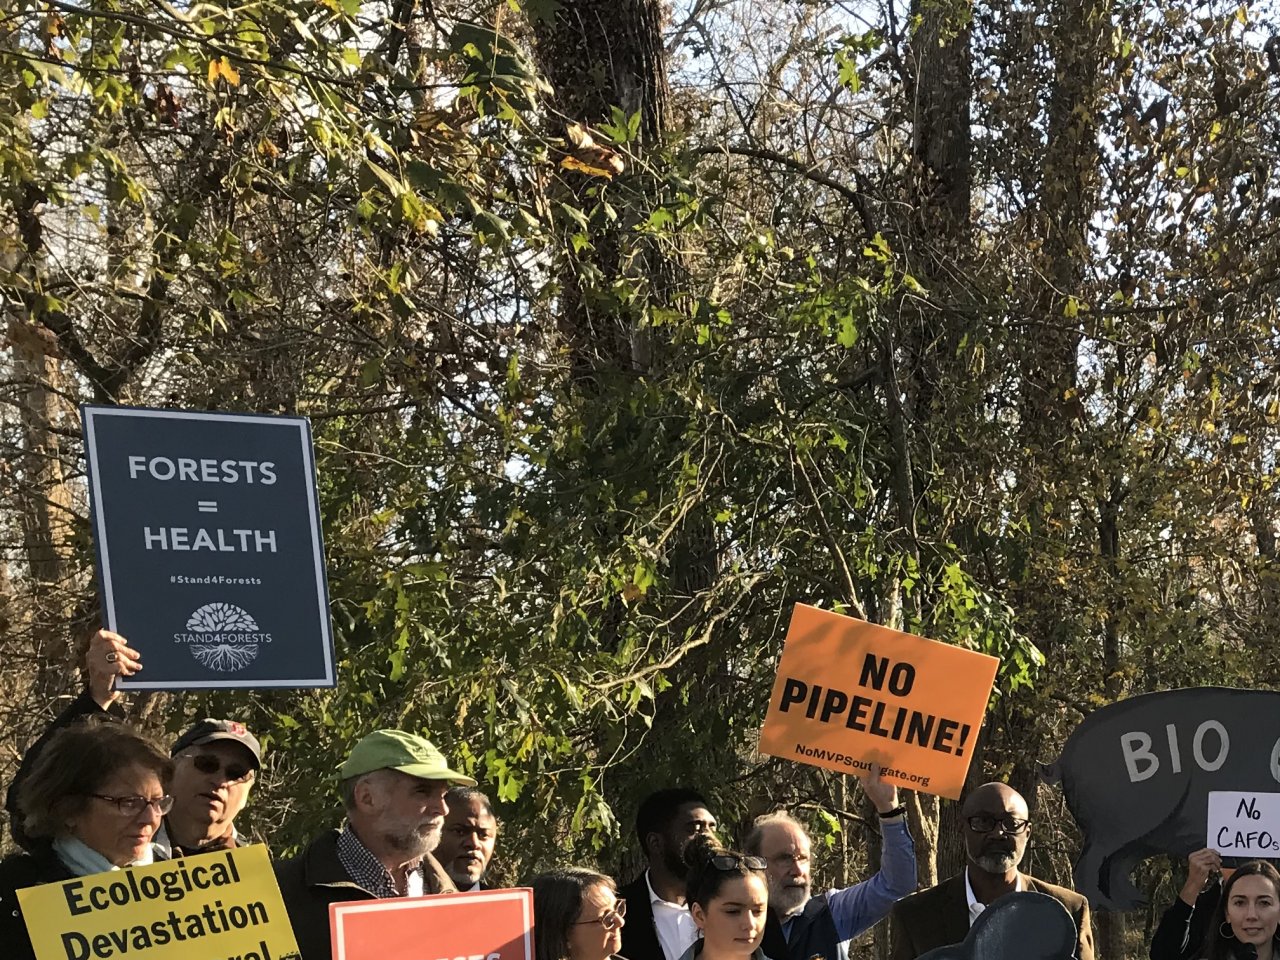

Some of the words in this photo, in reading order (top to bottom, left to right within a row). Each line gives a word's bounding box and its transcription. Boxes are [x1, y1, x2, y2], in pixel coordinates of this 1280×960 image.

[128, 456, 277, 485] FORESTS
[143, 527, 277, 552] HEALTH
[170, 576, 262, 585] #Stand4Forests
[173, 633, 273, 644] STAND4FORESTS
[858, 653, 916, 697] NO
[779, 678, 971, 757] PIPELINE!
[795, 744, 931, 787] NoMVPSoutgate.org
[1120, 720, 1230, 783] BIO
[1236, 798, 1261, 820] No
[1217, 827, 1279, 851] CAFOs
[62, 852, 240, 916] Ecological
